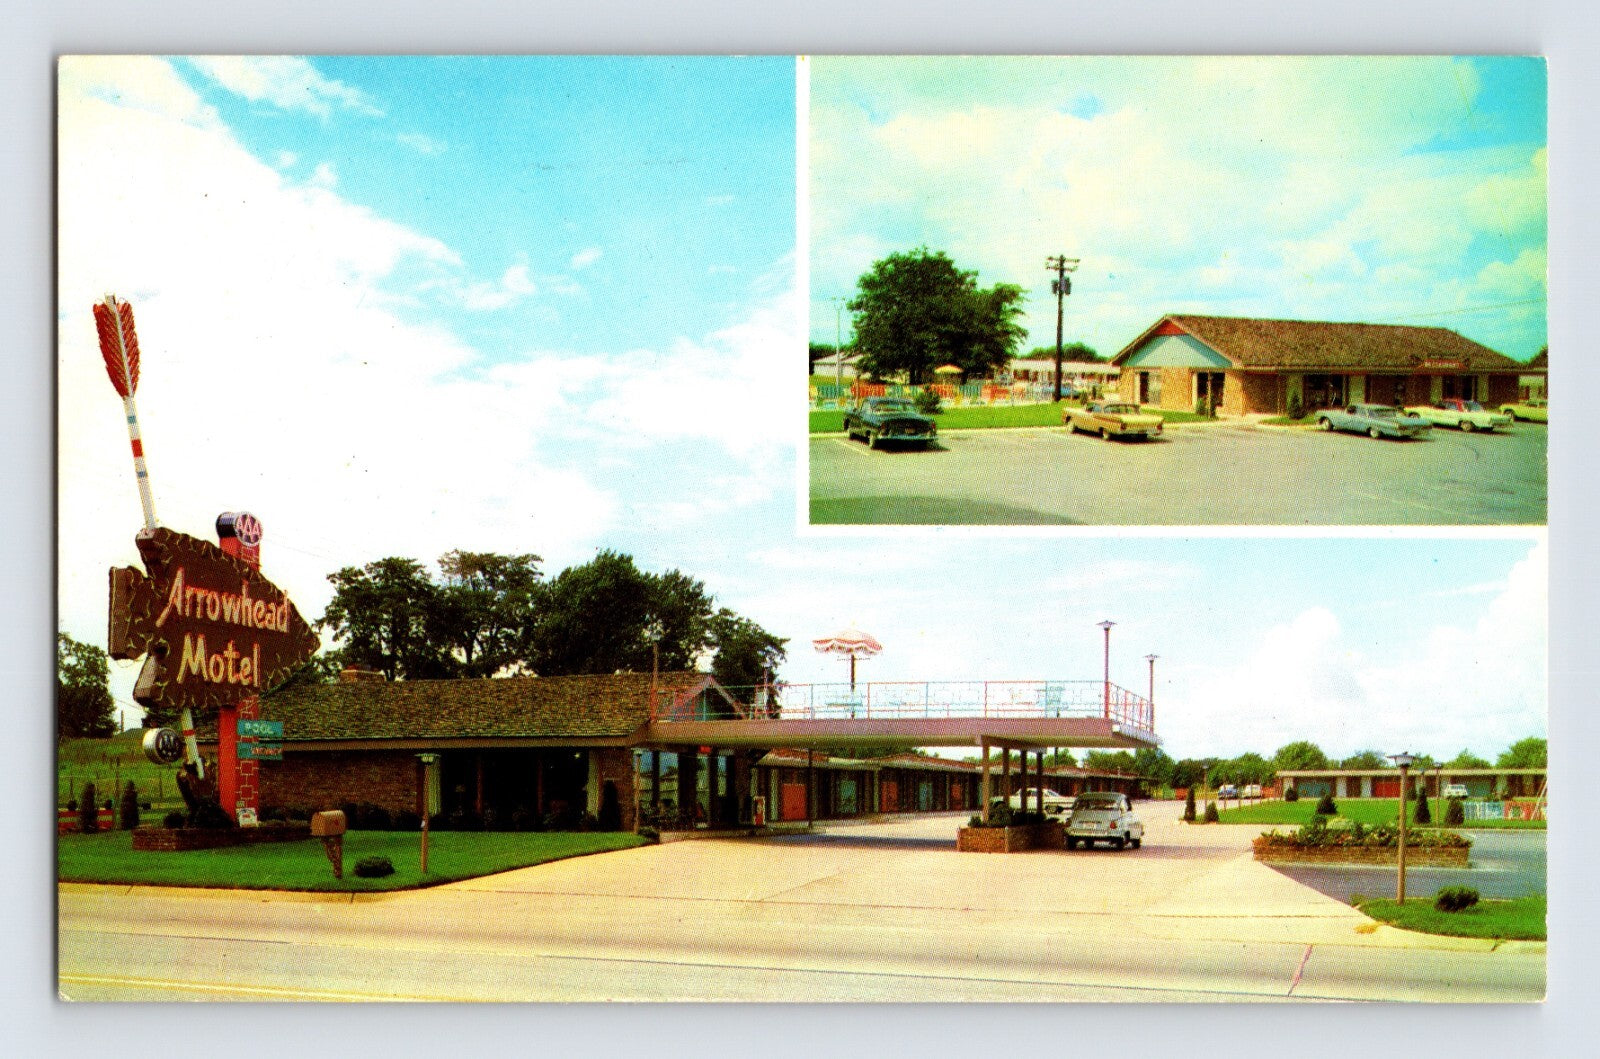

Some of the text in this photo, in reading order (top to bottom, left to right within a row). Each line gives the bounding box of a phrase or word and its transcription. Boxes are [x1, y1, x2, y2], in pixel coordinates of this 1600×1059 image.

[235, 514, 262, 543] AAA
[155, 567, 289, 633] Arrowhead
[177, 633, 261, 688] Motel
